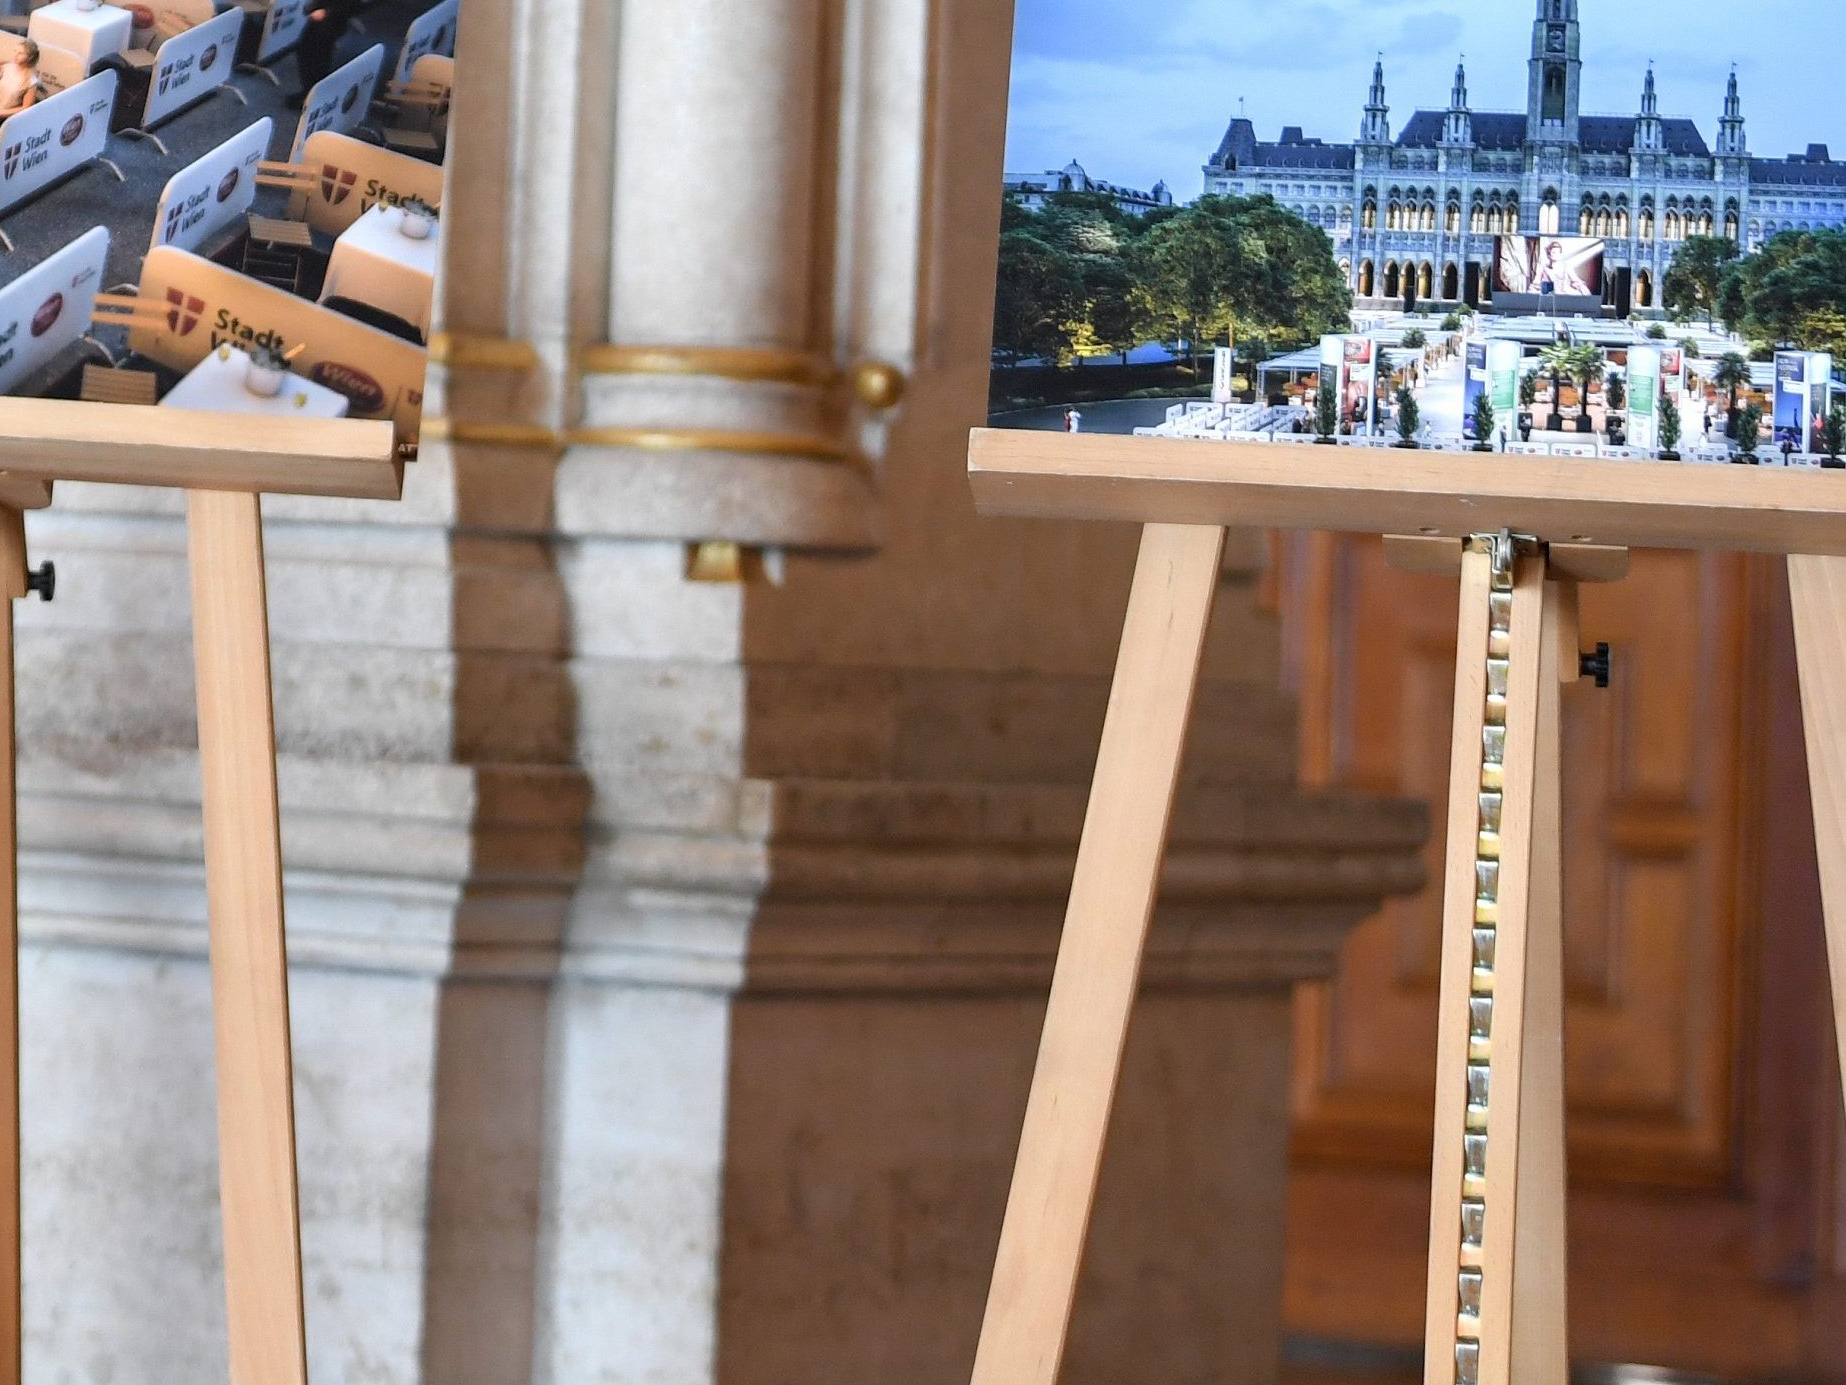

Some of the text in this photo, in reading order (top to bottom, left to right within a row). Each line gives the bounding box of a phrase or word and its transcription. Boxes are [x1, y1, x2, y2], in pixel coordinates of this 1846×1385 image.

[24, 127, 52, 154] Stadt
[22, 150, 48, 172] Wien
[185, 183, 211, 214] Stadt
[214, 308, 285, 349] Stadt
